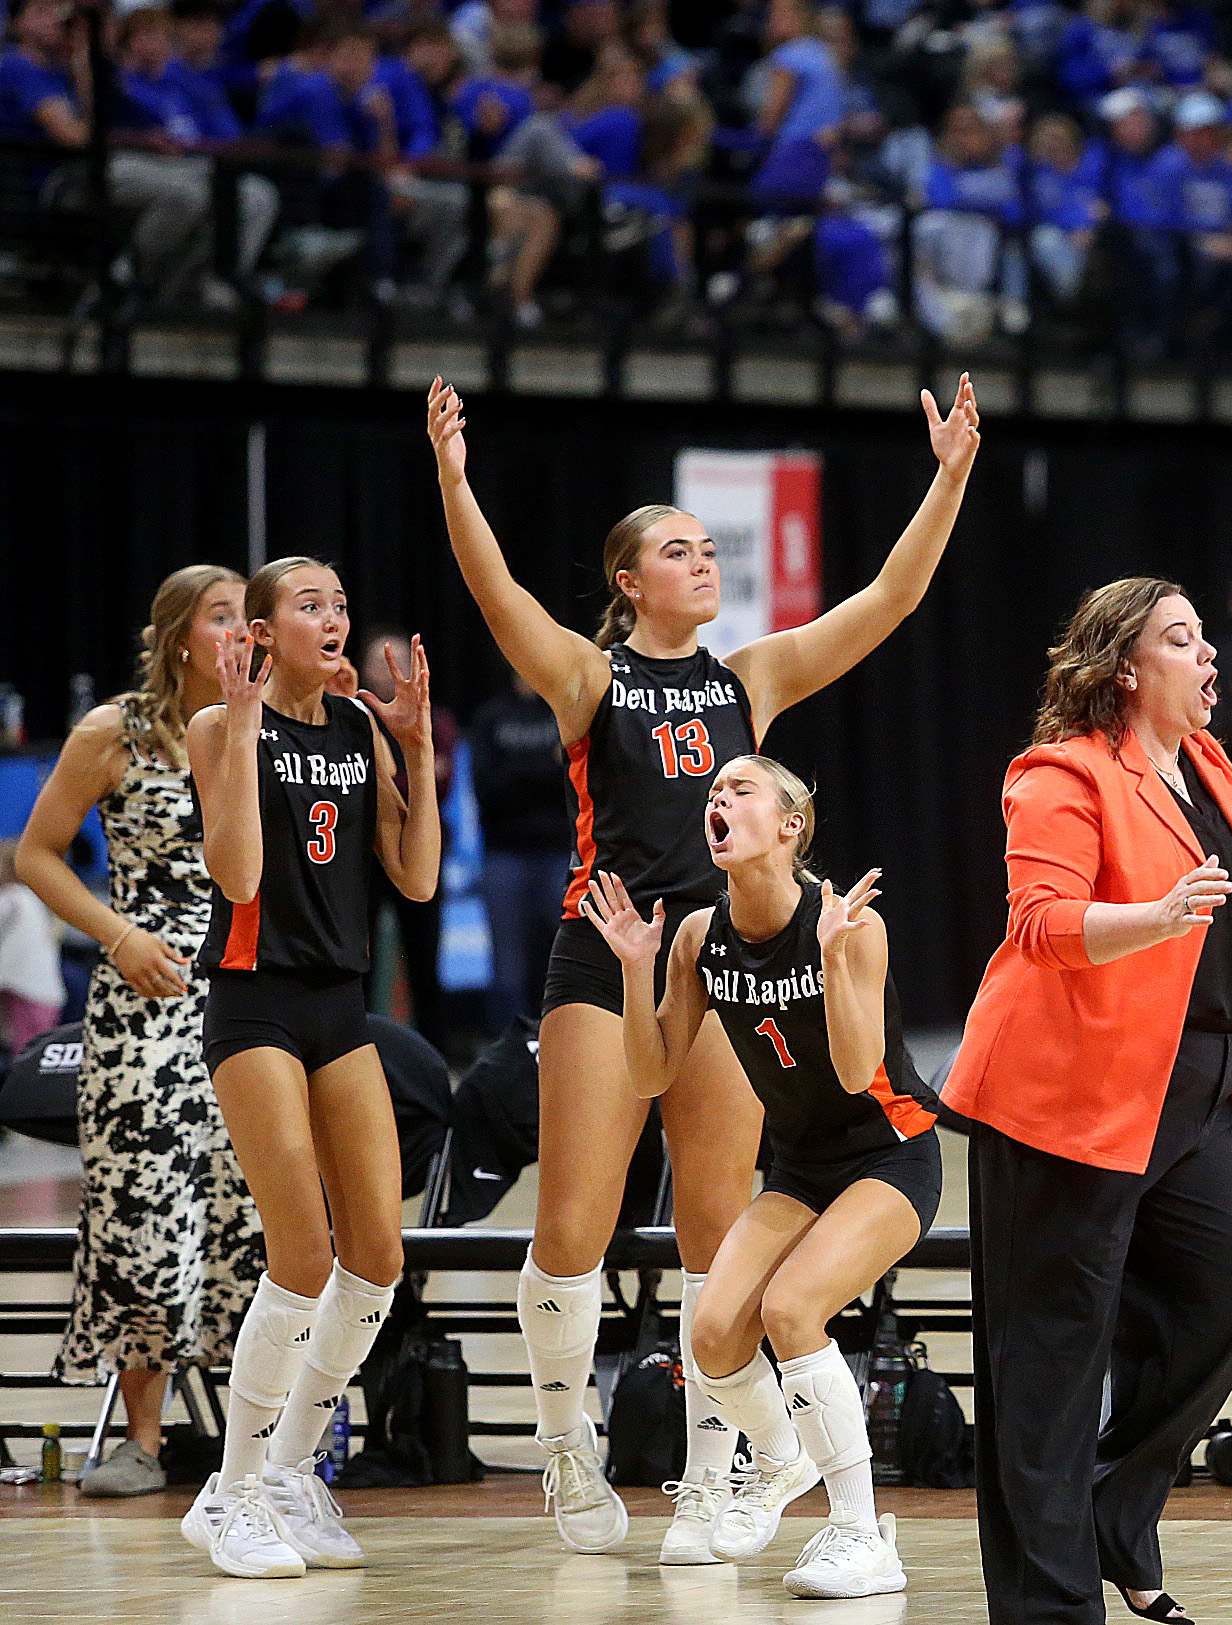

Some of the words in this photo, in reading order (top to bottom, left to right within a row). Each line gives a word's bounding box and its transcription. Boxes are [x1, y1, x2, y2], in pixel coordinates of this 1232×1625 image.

[612, 678, 657, 714] Dell
[663, 680, 737, 714] Rapids
[274, 752, 303, 784] ell
[307, 752, 369, 794] Rapid
[652, 718, 715, 778] 13
[307, 800, 338, 864] 3
[755, 1018, 796, 1068] 1
